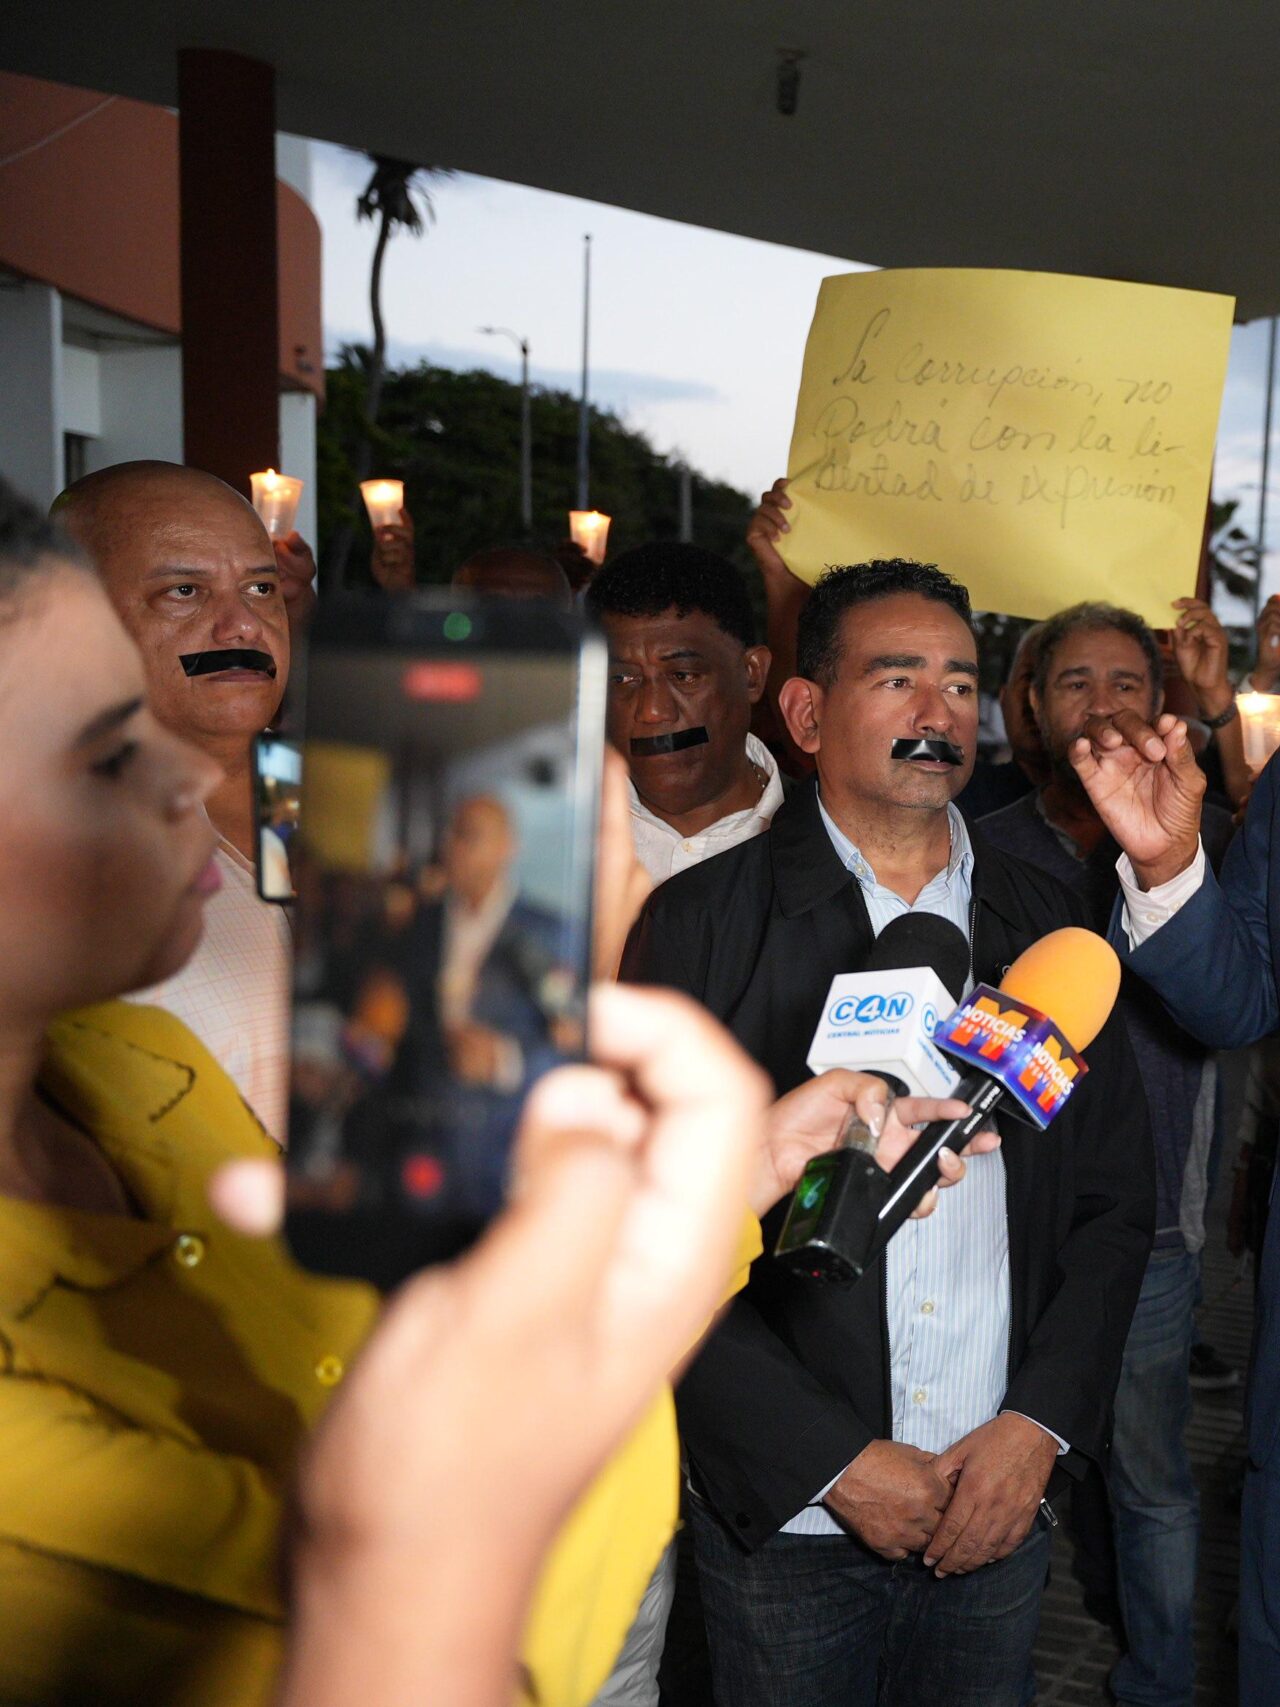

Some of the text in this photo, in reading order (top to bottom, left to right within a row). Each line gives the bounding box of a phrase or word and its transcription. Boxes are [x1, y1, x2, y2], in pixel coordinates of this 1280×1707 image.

[1116, 377, 1173, 405] no
[1070, 415, 1116, 453] la
[960, 463, 999, 504] de
[833, 994, 910, 1024] C4N
[961, 1004, 1027, 1042] NOTICIAS
[1031, 1041, 1075, 1096] NOTICIAS
